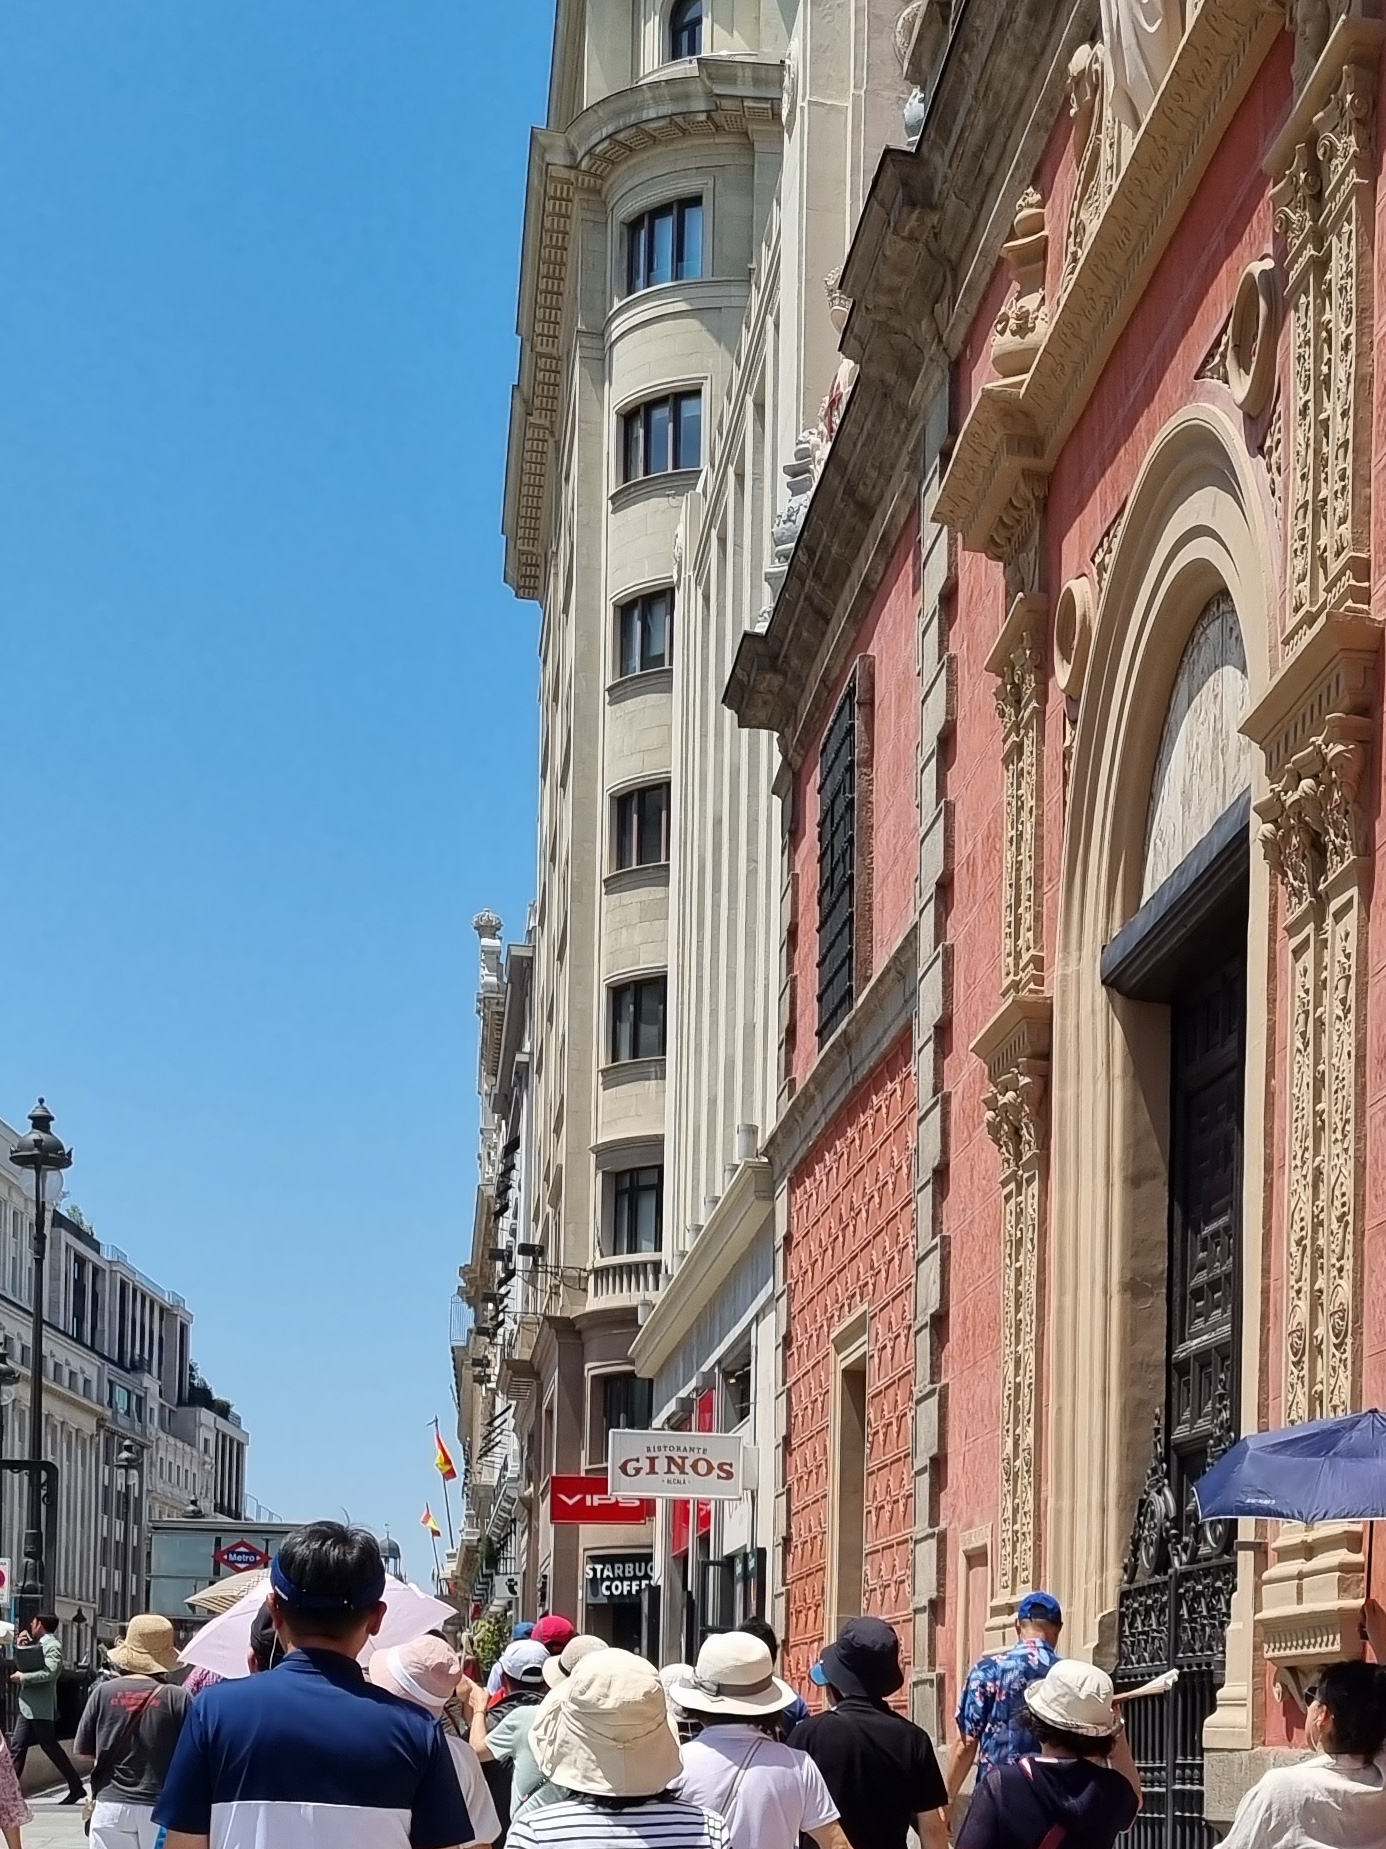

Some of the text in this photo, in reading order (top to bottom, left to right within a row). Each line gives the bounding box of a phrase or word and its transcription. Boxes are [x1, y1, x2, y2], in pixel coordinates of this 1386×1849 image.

[646, 1445, 708, 1455] RISTORANTE
[618, 1455, 735, 1481] GINOS
[556, 1493, 641, 1507] VIPS
[228, 1553, 255, 1562] Metro
[585, 1561, 653, 1579] STARBUC
[601, 1580, 650, 1596] COFF
